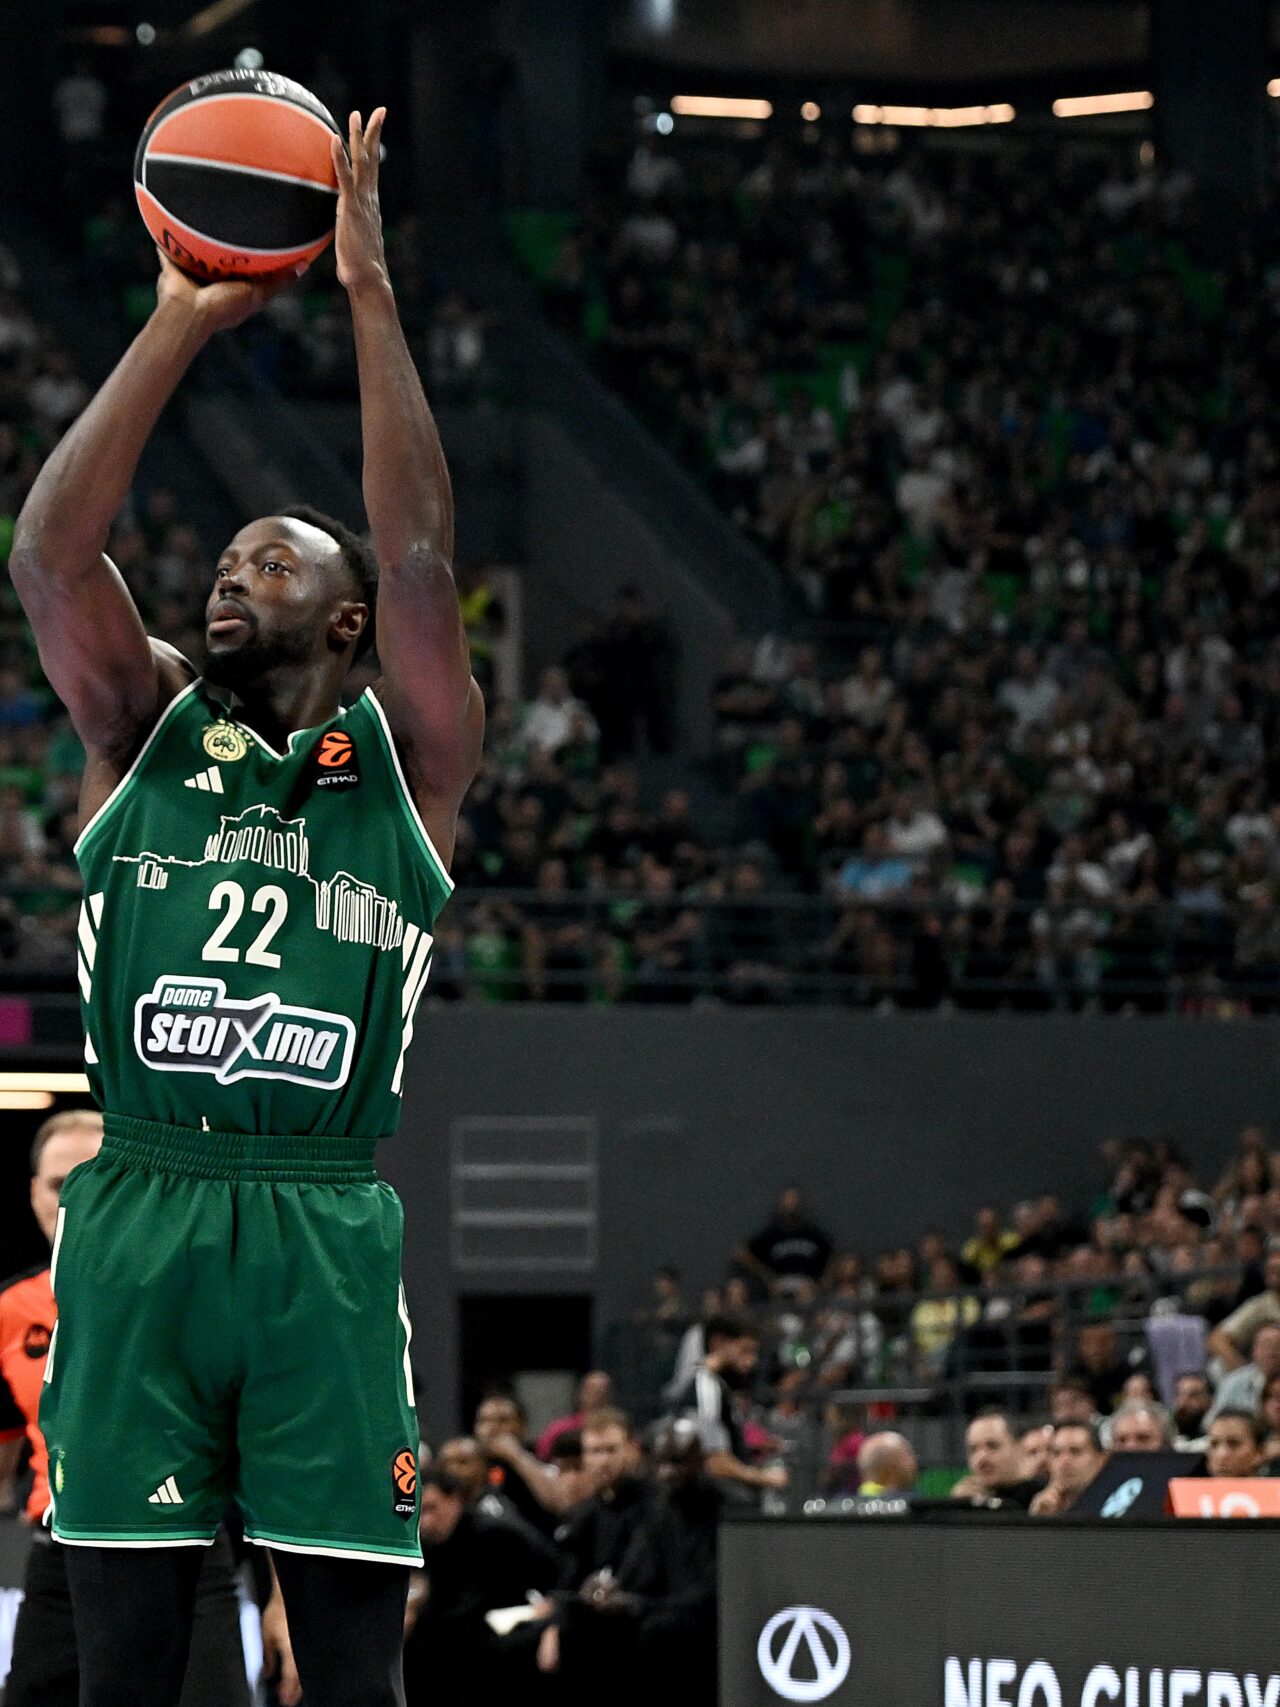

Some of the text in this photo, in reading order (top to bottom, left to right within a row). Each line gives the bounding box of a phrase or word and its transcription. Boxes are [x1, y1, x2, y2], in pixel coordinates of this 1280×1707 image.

[317, 774, 358, 786] ETIHAD
[201, 880, 289, 969] 22
[162, 987, 213, 1007] pame
